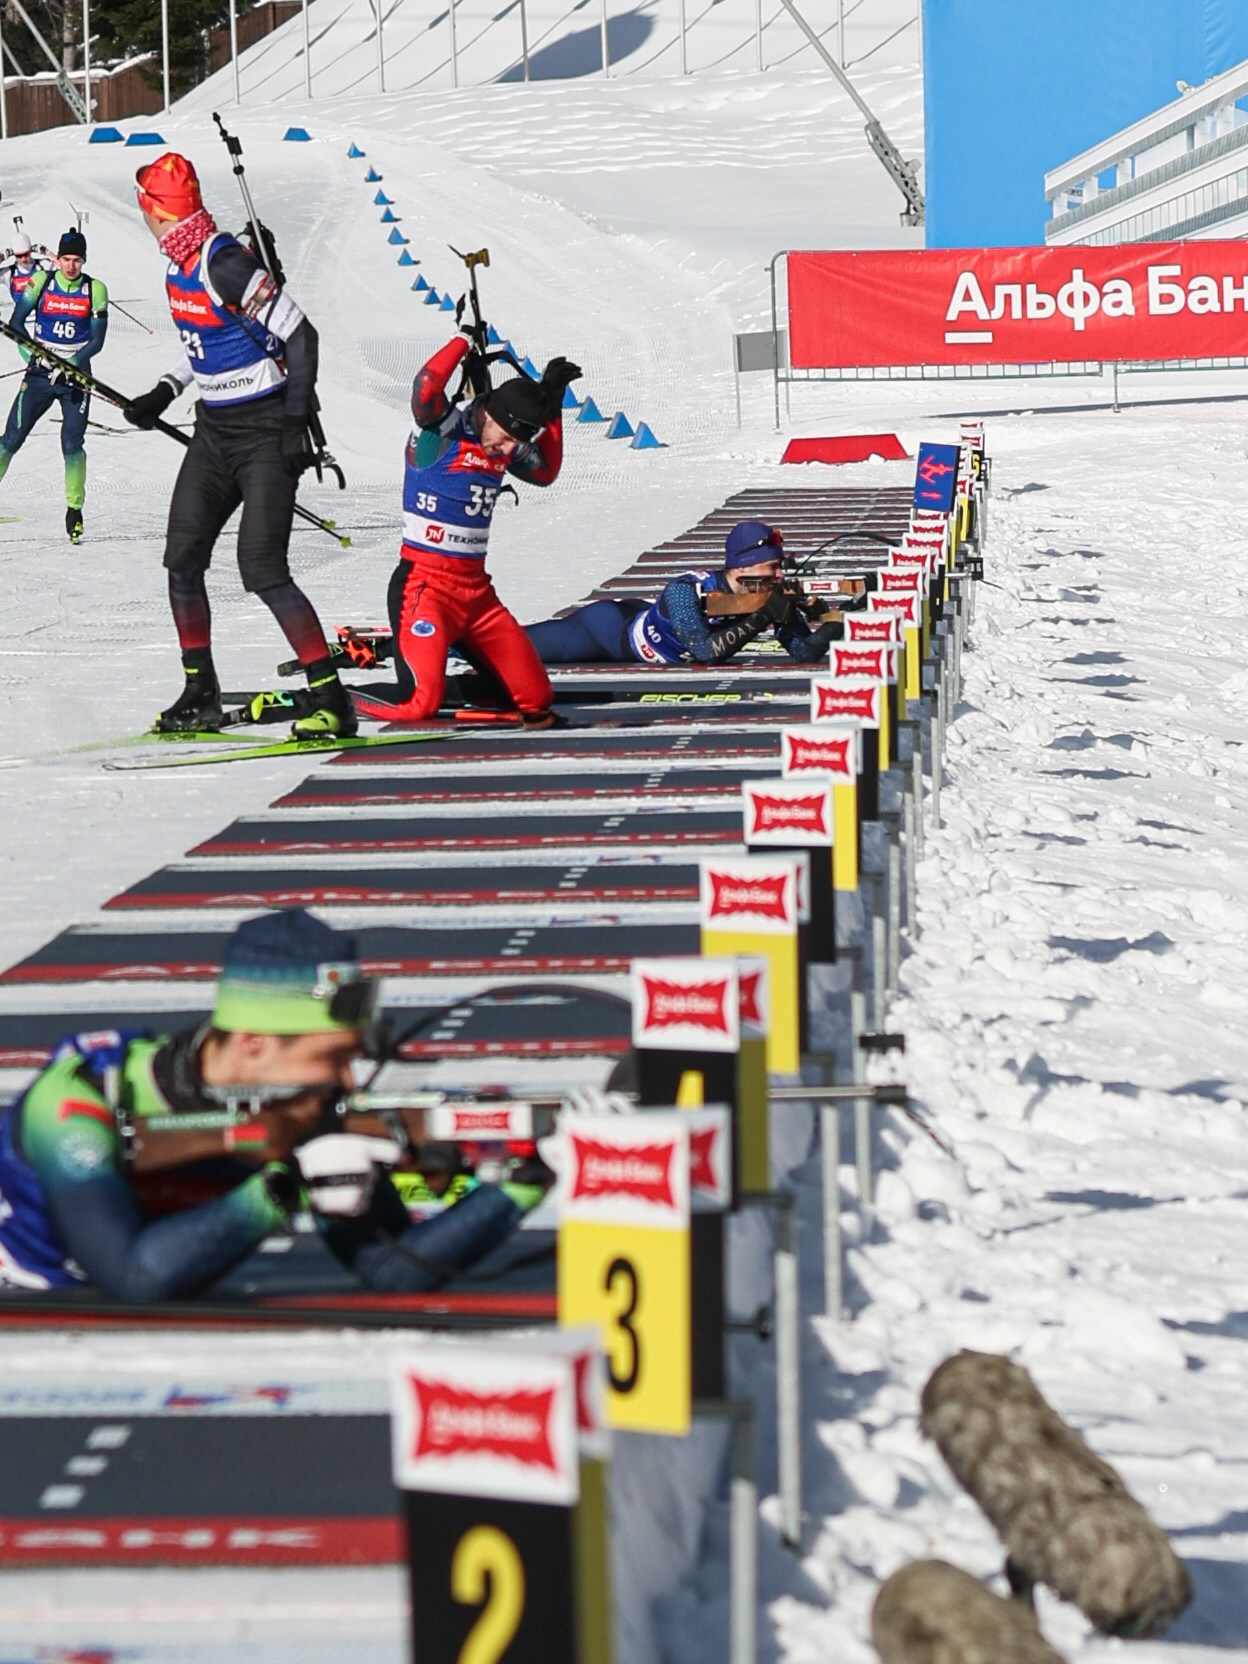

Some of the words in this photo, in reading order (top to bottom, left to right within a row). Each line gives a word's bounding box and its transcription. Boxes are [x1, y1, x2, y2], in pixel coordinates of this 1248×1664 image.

[187, 301, 208, 315] Банк
[945, 268, 1136, 332] Альфа
[52, 321, 76, 339] 46
[416, 492, 438, 513] 35
[464, 484, 497, 518] 35
[640, 693, 742, 704] FISCHER
[603, 1256, 640, 1394] 3
[451, 1523, 526, 1664] 2
